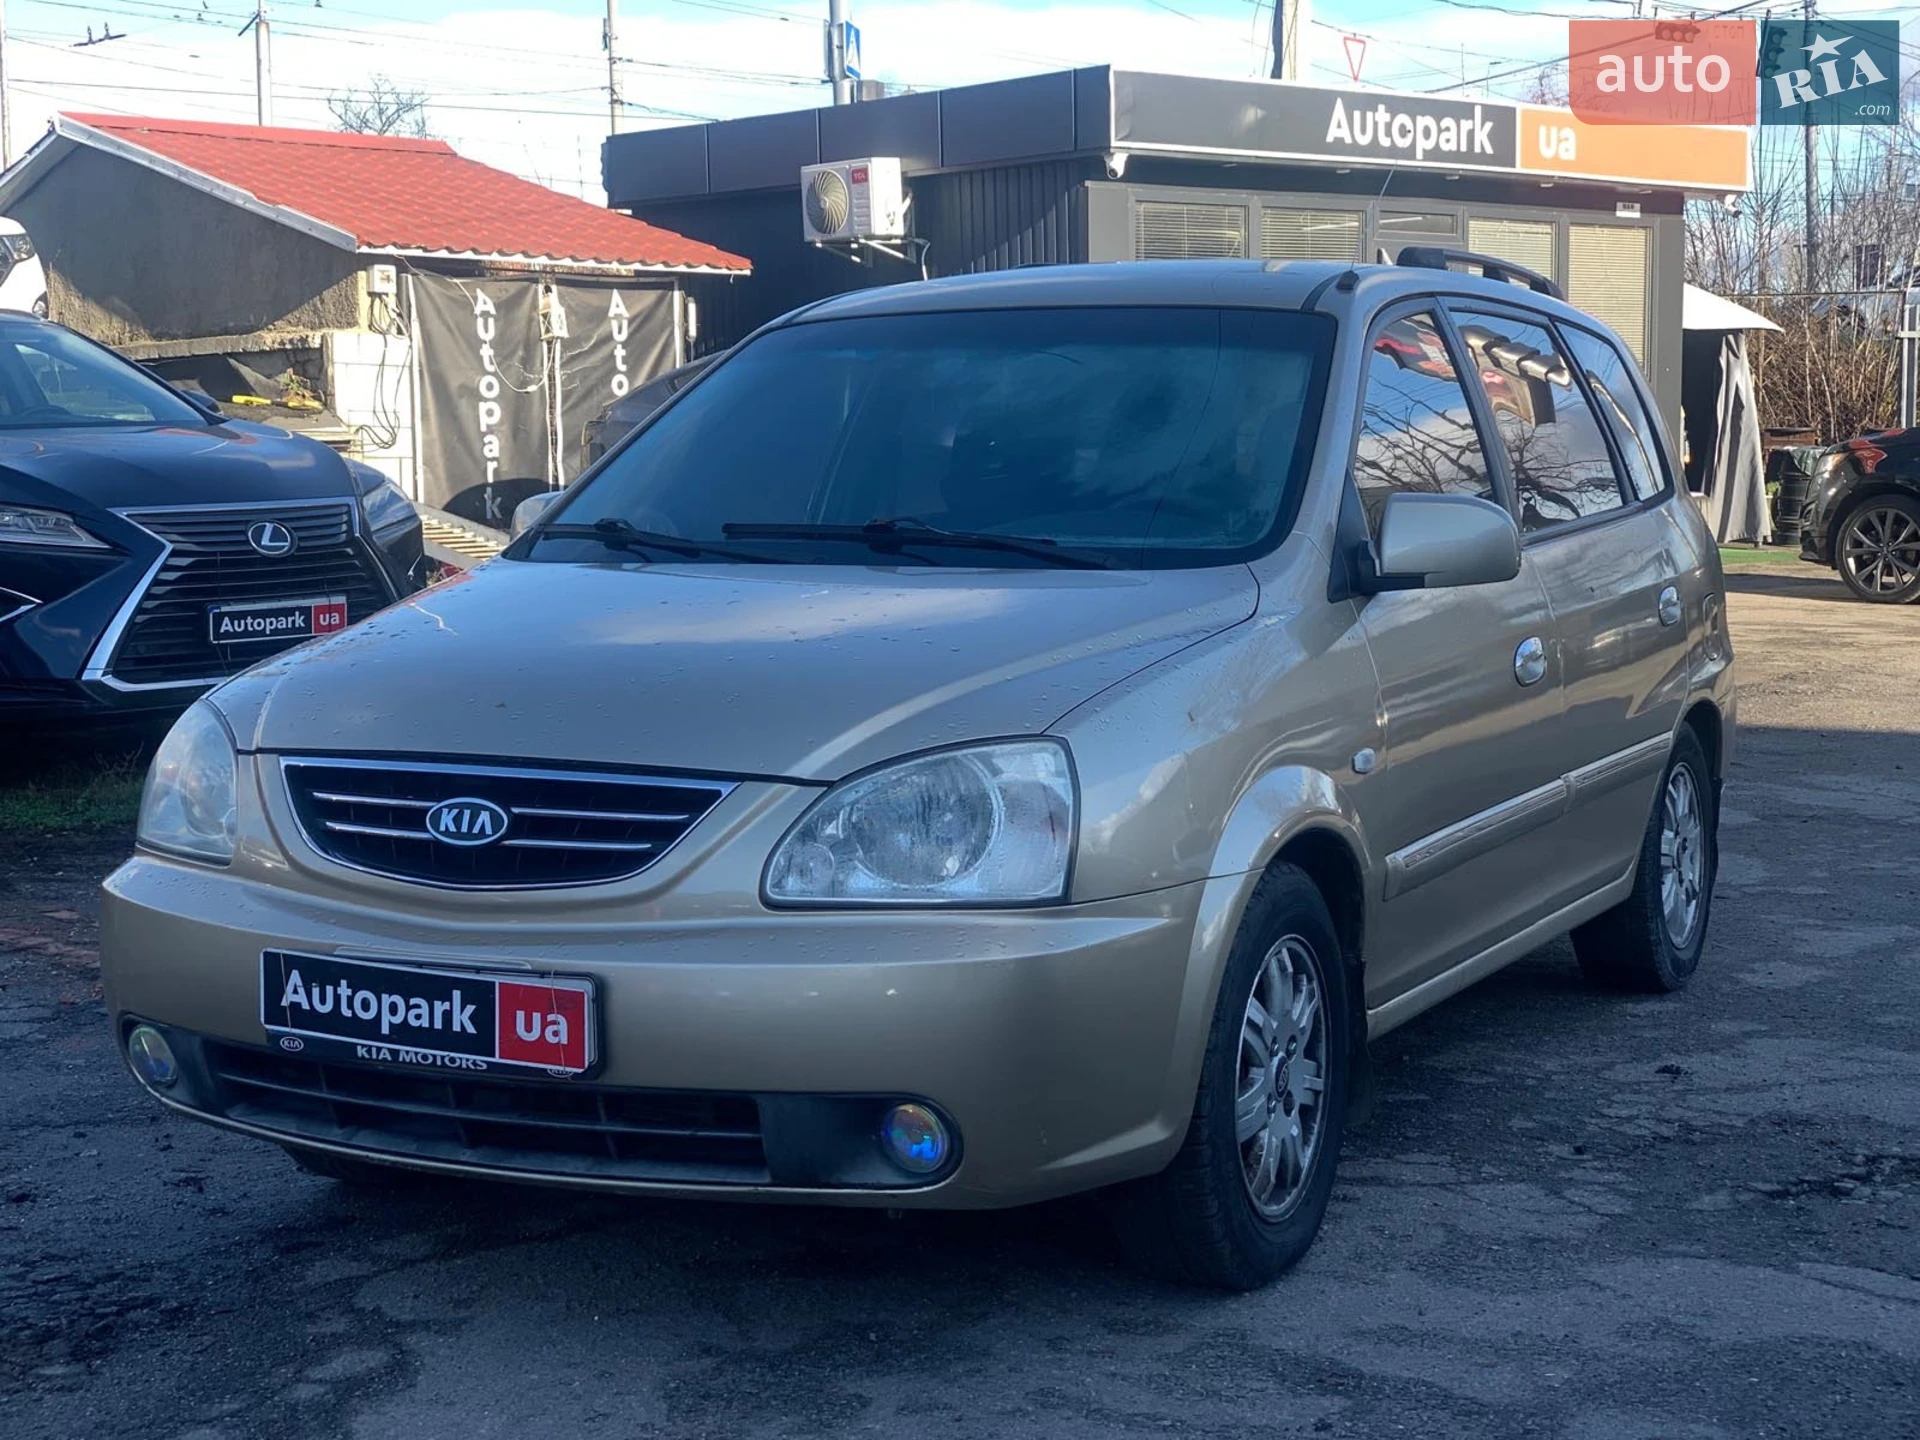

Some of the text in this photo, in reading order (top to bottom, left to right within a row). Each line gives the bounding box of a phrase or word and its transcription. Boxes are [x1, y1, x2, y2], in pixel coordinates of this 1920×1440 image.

[1325, 97, 1577, 160] Autopark ua
[474, 287, 502, 519] Autopark
[220, 611, 340, 634] Autopark ua
[439, 808, 493, 835] KIA
[280, 969, 569, 1045] Autopark ua
[283, 1039, 300, 1048] KIA
[356, 1045, 488, 1070] KIA MOTORS
